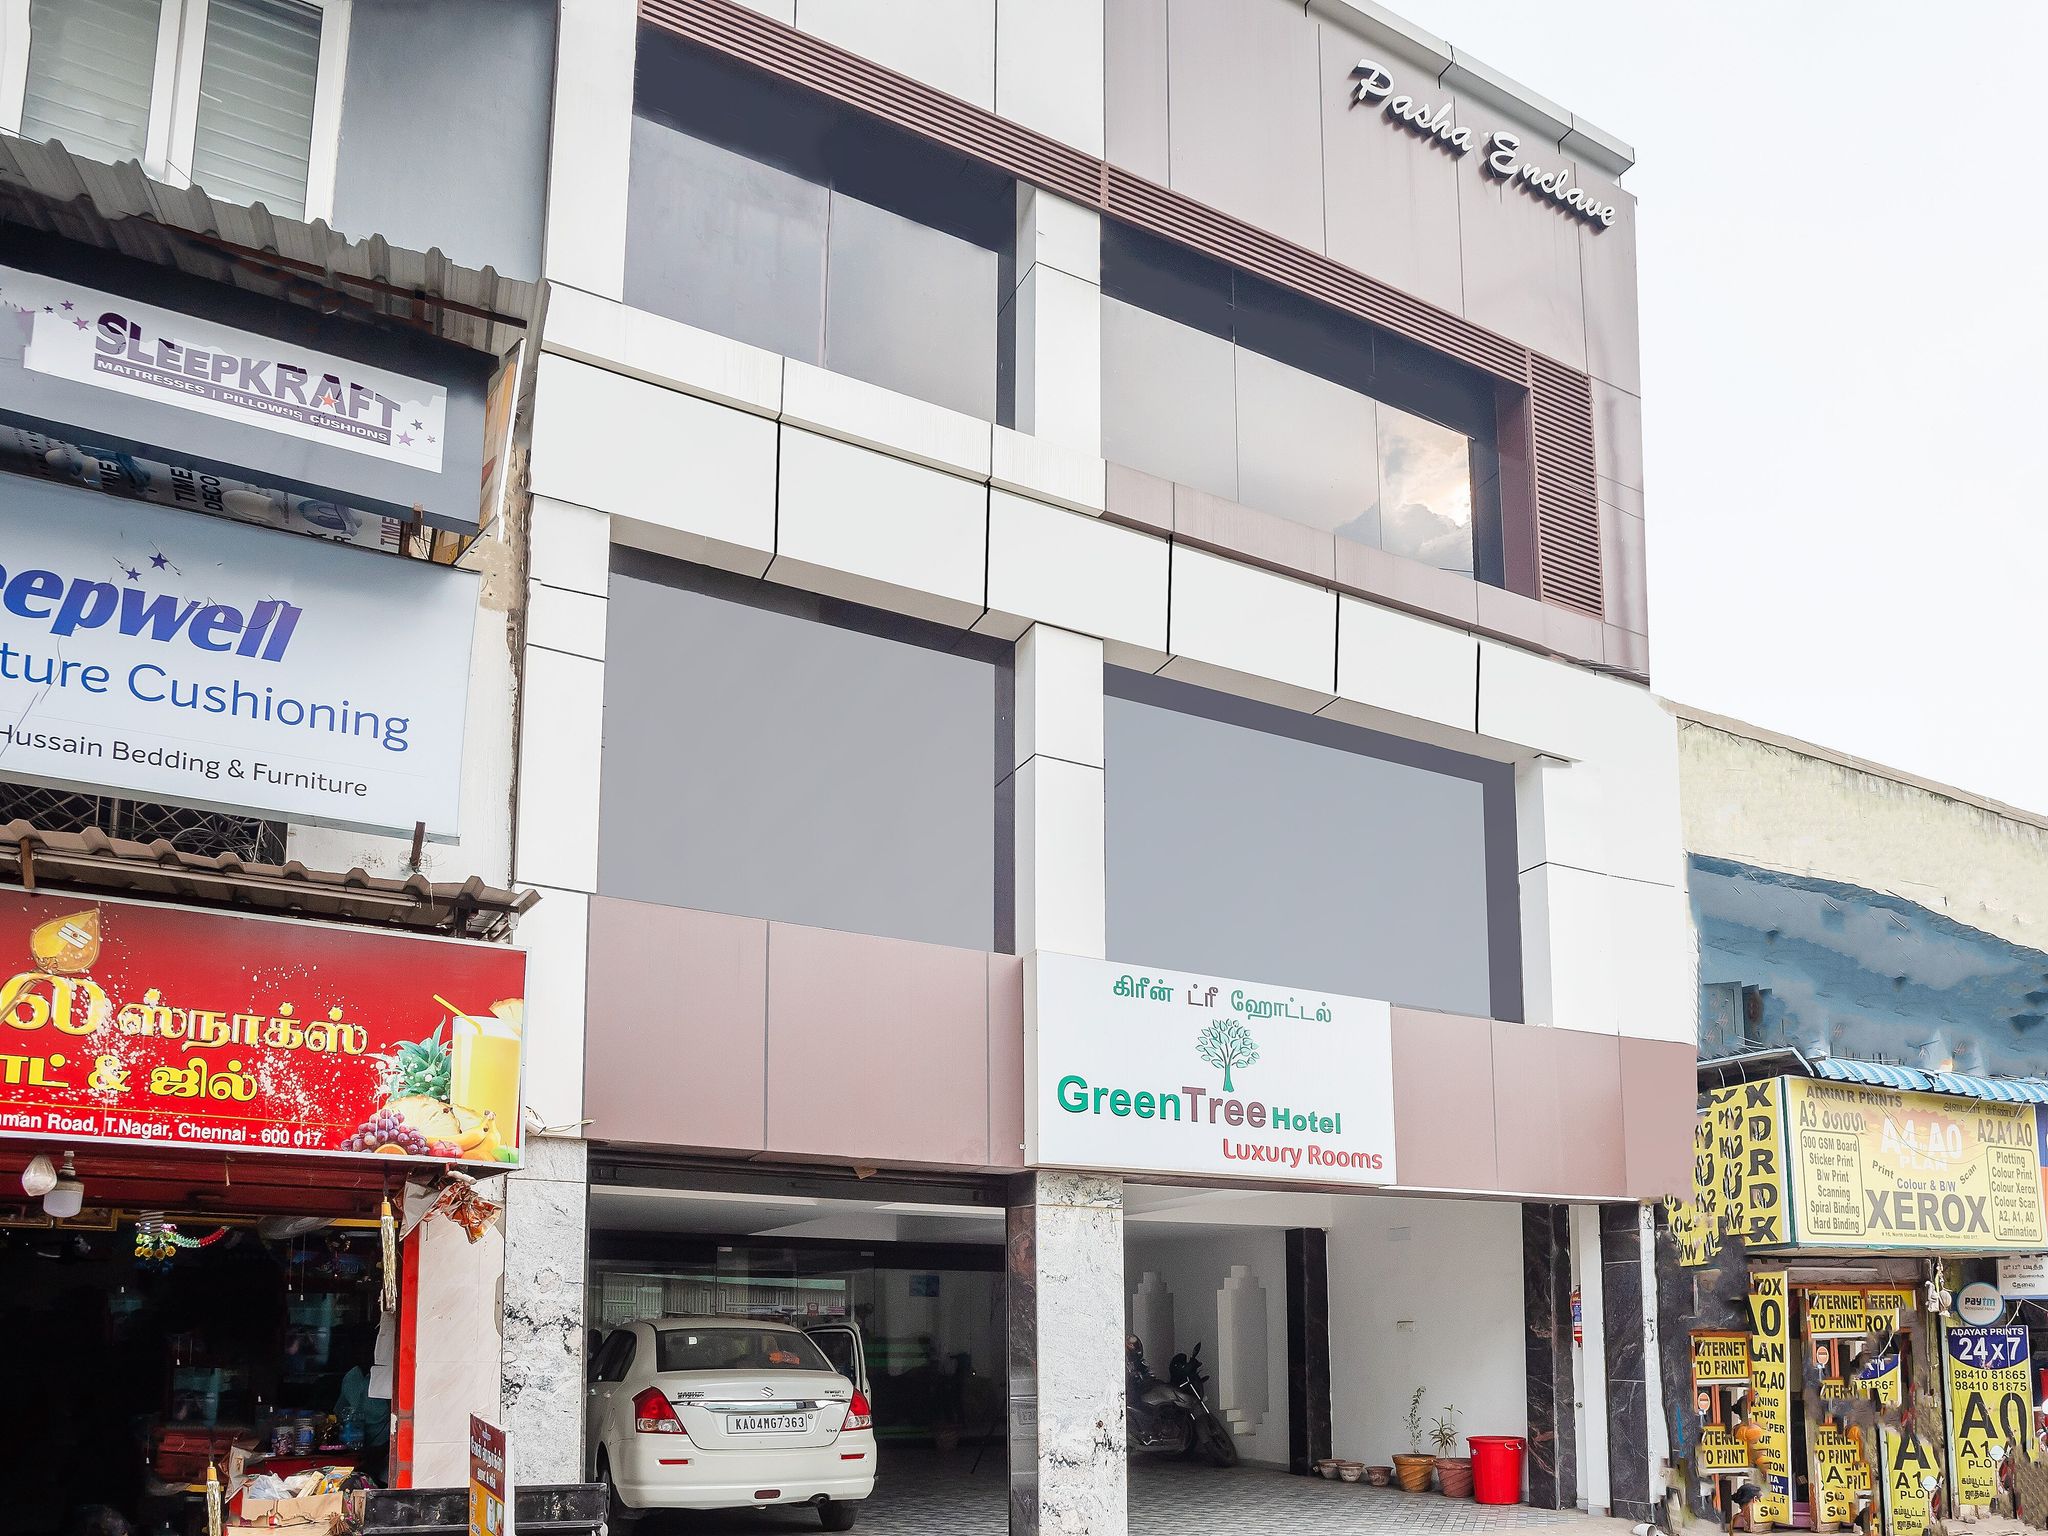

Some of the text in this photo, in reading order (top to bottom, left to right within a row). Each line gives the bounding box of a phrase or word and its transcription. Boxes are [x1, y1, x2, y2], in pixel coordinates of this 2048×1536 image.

[1355, 58, 1616, 227] Pasha Enclave
[95, 312, 401, 429] SLEEPKRAFT
[97, 360, 206, 395] MATTRESSES
[309, 415, 389, 443] CUSHIONS
[0, 564, 303, 663] epwell
[127, 663, 410, 752] Cushioning
[112, 740, 220, 780] Bedding
[227, 759, 245, 779] &
[253, 762, 368, 798] Furniture
[1112, 974, 1175, 1003] கிரீன்
[1230, 989, 1332, 1023] ஹோட்டல்
[149, 1057, 258, 1101] ஜில்
[1859, 1090, 1903, 1108] PRINTS
[0, 1112, 42, 1129] man
[47, 1113, 99, 1135] Road,
[105, 1117, 173, 1139] T.Nagar,
[178, 1122, 246, 1141] Chennai
[261, 1128, 290, 1145] 600
[1272, 1106, 1342, 1135] Hotel
[1803, 1135, 1858, 1152] 300 GSM Board
[1222, 1138, 1384, 1170] Luxury Rooms
[1809, 1152, 1854, 1168] Sticker Print
[1996, 1151, 2026, 1169] Plotting
[1831, 1170, 1850, 1183] Print
[1872, 1159, 1977, 1185] Print Scan
[1991, 1166, 2033, 1181] Colour Print
[1817, 1184, 1851, 1202] Scanning
[1896, 1177, 1927, 1191] Colour
[1930, 1179, 1937, 1191] &
[1991, 1181, 2036, 1195] Colour Xerox
[1810, 1200, 1860, 1218] Spiral Binding
[1865, 1189, 1991, 1233] XEROX
[1994, 1195, 2036, 1209] Colour Scan
[1813, 1216, 1860, 1234] Hard Binding
[1998, 1224, 2038, 1238] Lamination
[1964, 1296, 1996, 1307] paytm
[1811, 1313, 1826, 1330] TO
[1951, 1328, 2024, 1337] ADAYAR PRINTS
[1697, 1360, 1711, 1376] TO
[1954, 1370, 2026, 1380] 98410 81865
[1955, 1381, 2027, 1392] 98410 81875
[735, 1417, 805, 1431] KA04MG7363
